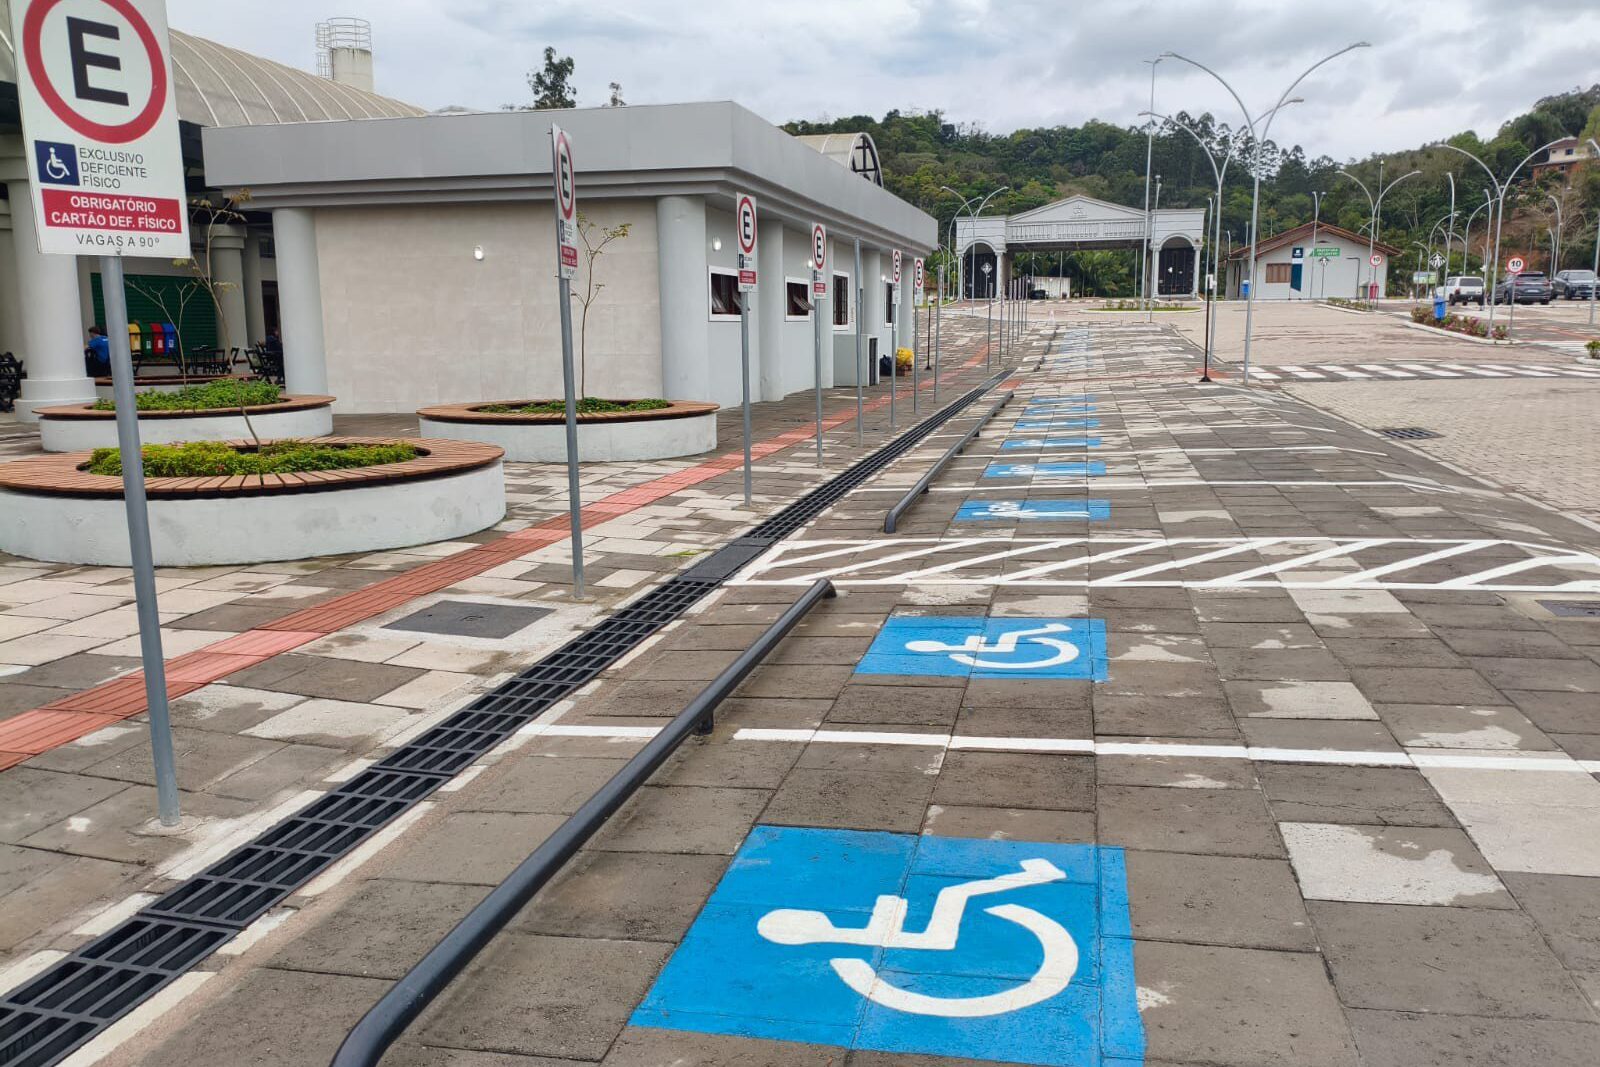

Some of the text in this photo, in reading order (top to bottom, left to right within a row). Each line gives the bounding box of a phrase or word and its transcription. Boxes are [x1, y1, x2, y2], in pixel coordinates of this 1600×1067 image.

[66, 16, 129, 106] E
[79, 147, 144, 165] EXCLUSIVO
[80, 161, 148, 178] DEFICIENTE
[560, 153, 570, 199] E
[82, 174, 121, 189] FÍSICO
[70, 195, 157, 213] OBRIGATÓRIO
[51, 211, 176, 230] CARTÃO DEF. FÍSICO
[743, 211, 751, 240] E
[76, 234, 124, 247] VAGAS
[127, 236, 136, 247] A
[817, 236, 822, 259] E
[1511, 260, 1522, 268] 10
